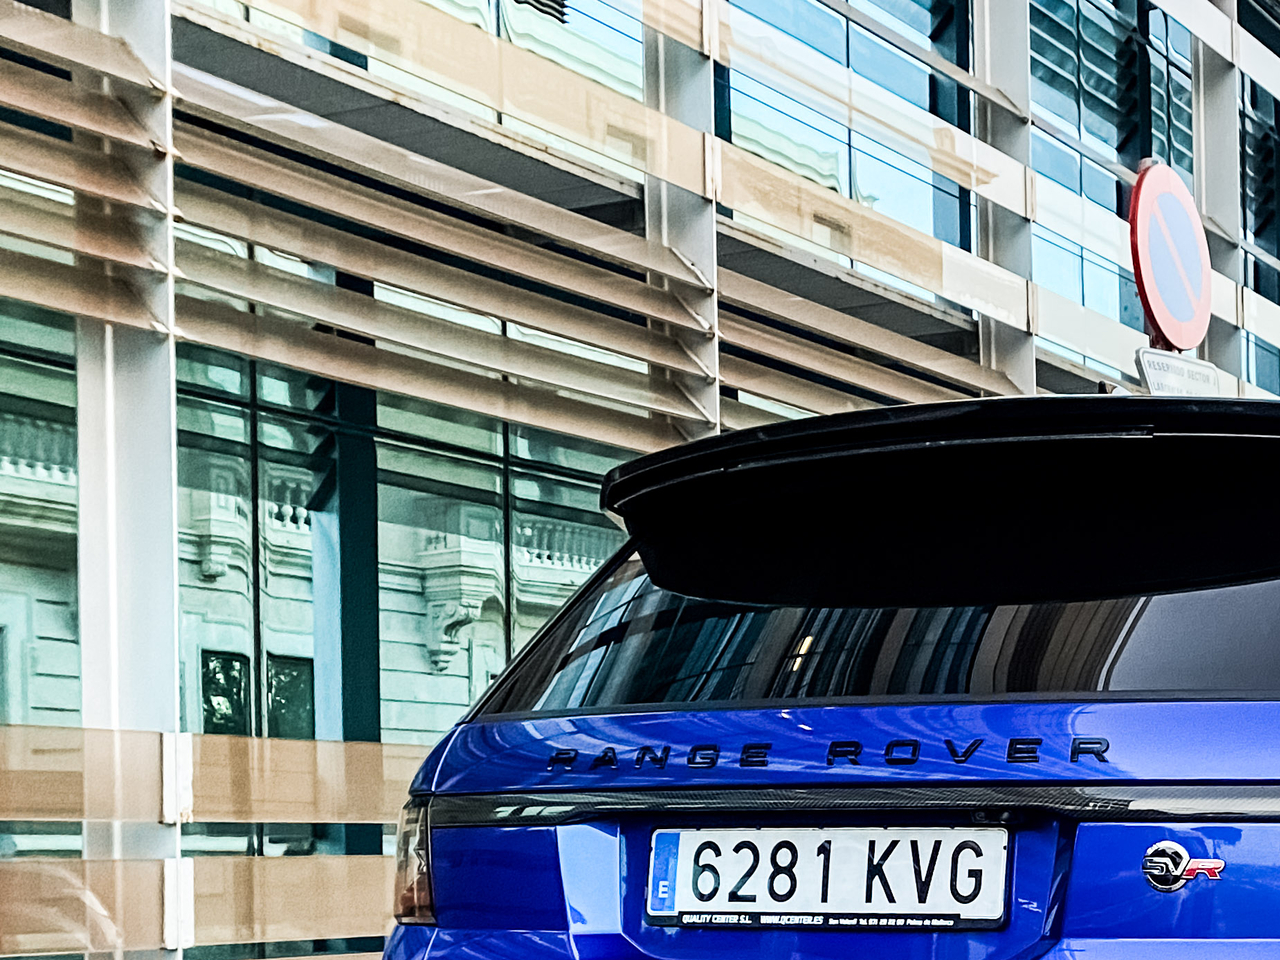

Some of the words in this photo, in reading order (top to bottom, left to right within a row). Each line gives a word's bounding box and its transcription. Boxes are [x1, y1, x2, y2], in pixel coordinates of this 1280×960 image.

[546, 743, 772, 770] RANGE
[826, 738, 1110, 766] ROVER
[692, 840, 832, 903] 6281
[865, 840, 984, 904] KVG
[658, 881, 669, 898] E
[682, 915, 711, 924] QUALITY
[711, 915, 739, 924] CENTER
